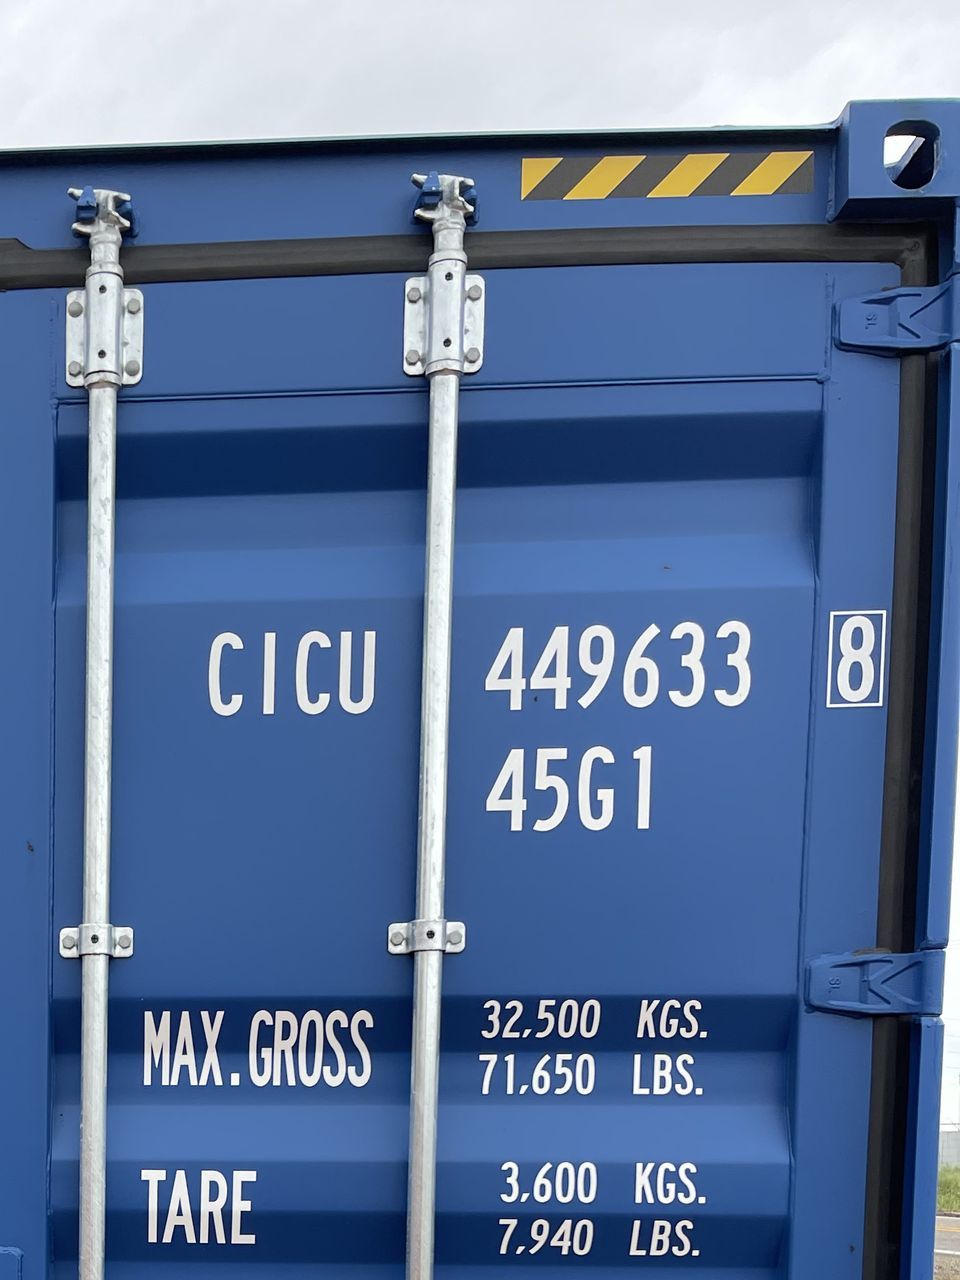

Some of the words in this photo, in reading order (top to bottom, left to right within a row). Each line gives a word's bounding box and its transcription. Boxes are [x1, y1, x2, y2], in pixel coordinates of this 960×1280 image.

[208, 630, 377, 717] CICU
[484, 620, 752, 711] 449633
[836, 615, 876, 703] 8
[485, 745, 652, 832] 45G1
[143, 1009, 374, 1088] MAX.GROSS
[481, 999, 601, 1039] 32,500
[636, 999, 708, 1039] KGS.
[478, 1053, 596, 1095] 71,650
[632, 1053, 703, 1096] LBS.
[140, 1169, 257, 1245] TARE
[500, 1161, 598, 1204] 3,600
[634, 1162, 706, 1205] KGS.
[498, 1218, 594, 1256] 7,940
[629, 1219, 700, 1257] LBS.
